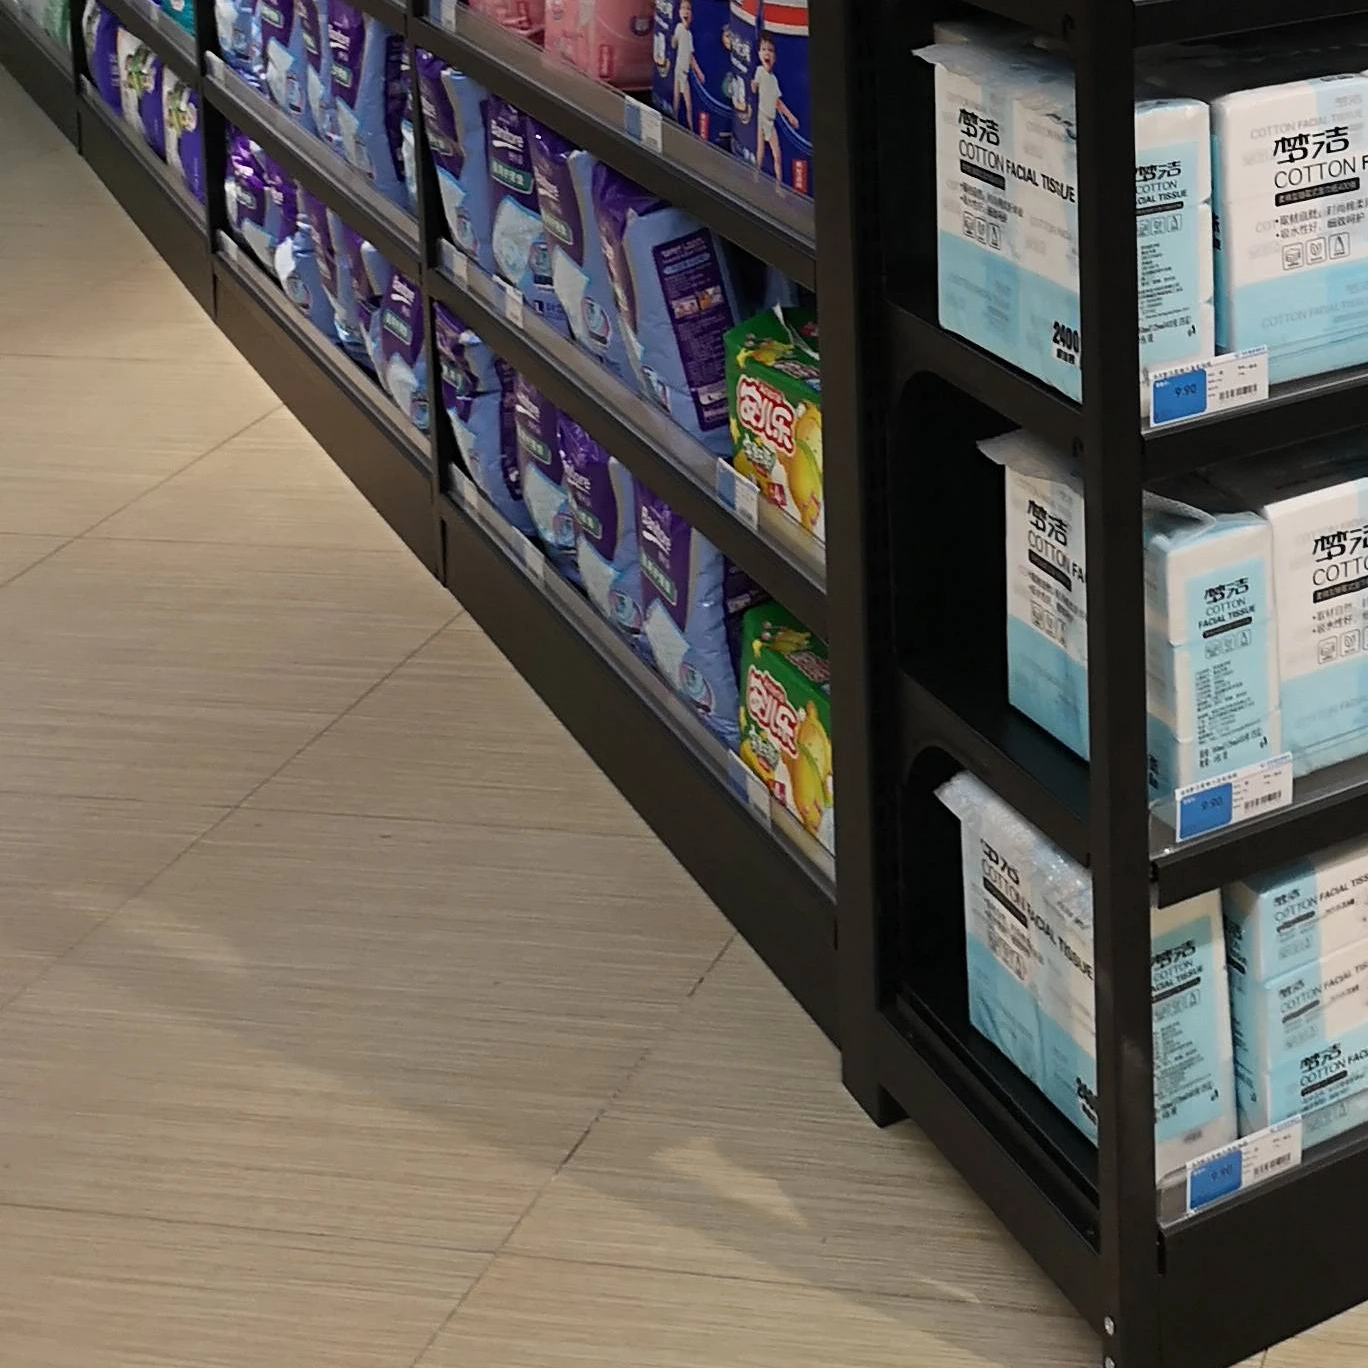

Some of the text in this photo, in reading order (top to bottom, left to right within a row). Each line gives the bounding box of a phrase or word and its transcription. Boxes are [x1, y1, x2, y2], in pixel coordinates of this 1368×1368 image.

[959, 109, 1000, 146] 梦洁
[1273, 127, 1349, 164] 梦洁
[960, 140, 1075, 202] COTTON FACIAL TISSUE
[1275, 157, 1355, 188] COTTON
[1174, 384, 1196, 397] 9.90
[1028, 500, 1068, 549] 梦洁
[1029, 531, 1067, 568] COTTON
[1199, 606, 1254, 628] FACIAL TISSUE
[1207, 599, 1249, 617] COTTON
[1301, 1061, 1347, 1088] COTTON
